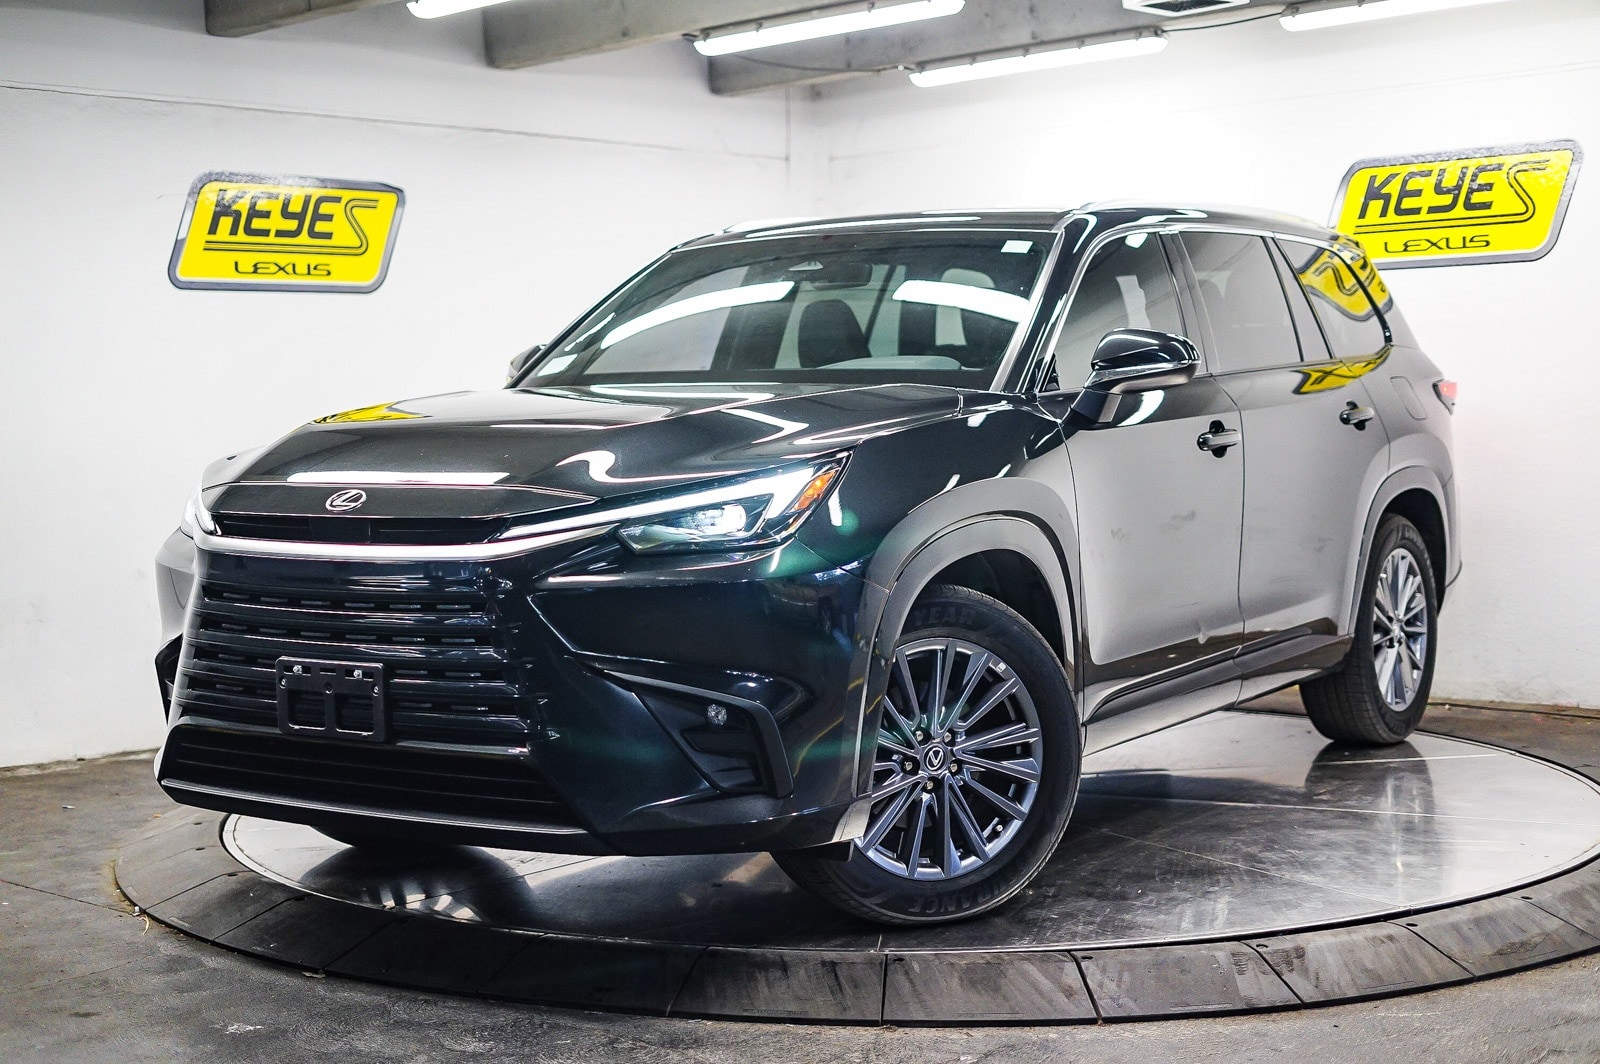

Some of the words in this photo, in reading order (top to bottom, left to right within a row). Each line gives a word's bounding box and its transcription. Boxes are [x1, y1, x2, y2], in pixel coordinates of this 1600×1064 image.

[1353, 159, 1550, 234] KEYES
[204, 189, 379, 256] KEYES
[1384, 234, 1491, 254] LEXUS
[234, 261, 332, 277] LEXUS
